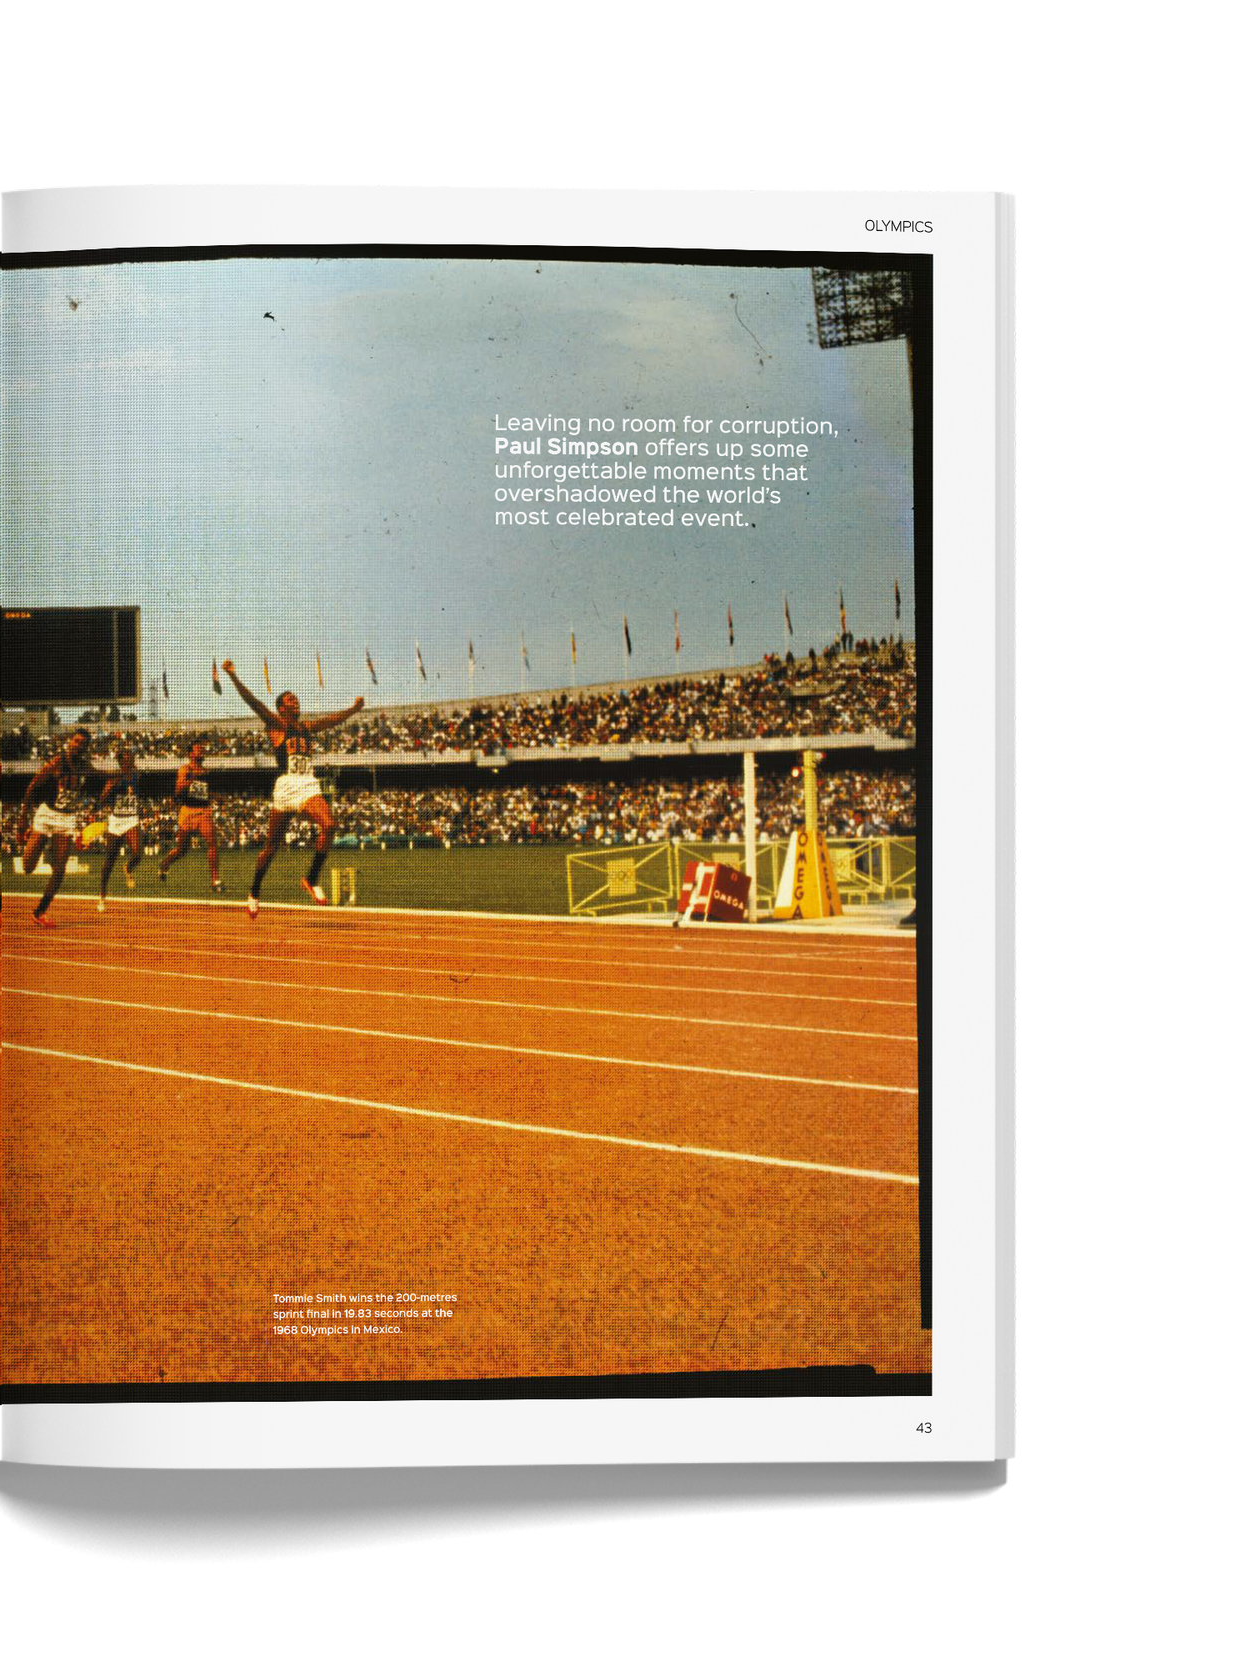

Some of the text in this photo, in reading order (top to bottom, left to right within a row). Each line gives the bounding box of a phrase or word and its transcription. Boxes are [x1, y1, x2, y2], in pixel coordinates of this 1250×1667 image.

[864, 219, 934, 234] OLYMPICS
[495, 414, 839, 438] Leaving no room for corruption,
[495, 437, 809, 460] Paul Simpson offers up some
[494, 460, 808, 482] unforgettable moments that
[494, 485, 781, 504] overshadowed the world’s
[494, 508, 749, 527] most celebrated event.
[792, 831, 809, 919] OMEGA
[713, 889, 744, 909] OMEGA
[273, 1293, 457, 1303] Tommie Smith wins the 200-metres
[273, 1308, 453, 1320] sprint final in 19.83 seconds at the
[273, 1325, 403, 1336] 1968 Olympics in Mexico.
[915, 1421, 933, 1434] 43
